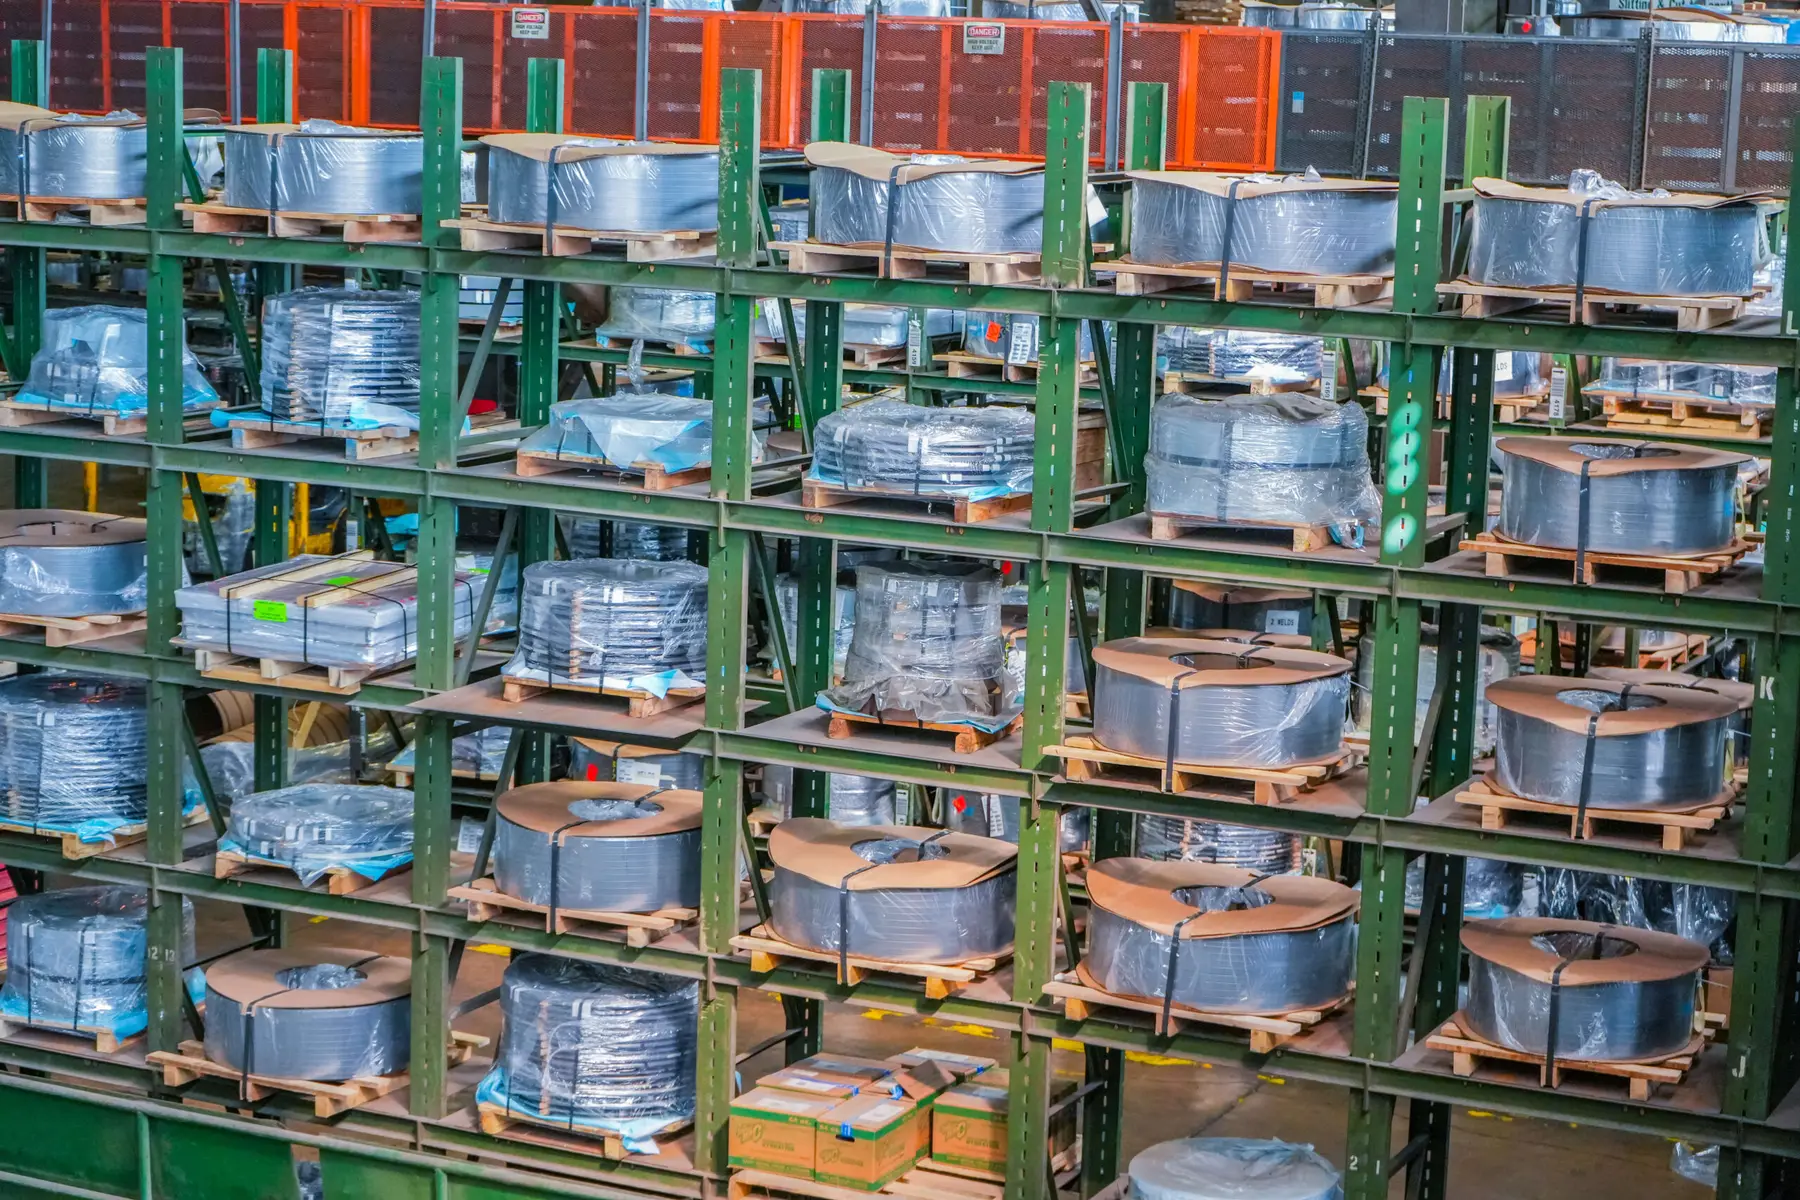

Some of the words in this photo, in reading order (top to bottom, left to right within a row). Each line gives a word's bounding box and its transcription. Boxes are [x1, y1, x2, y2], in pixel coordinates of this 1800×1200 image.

[1618, 0, 1650, 9] Slittin
[970, 28, 998, 36] DANGER
[1786, 310, 1799, 335] L
[1760, 675, 1775, 700] K
[1732, 1055, 1746, 1078] J
[1349, 1155, 1358, 1171] 2
